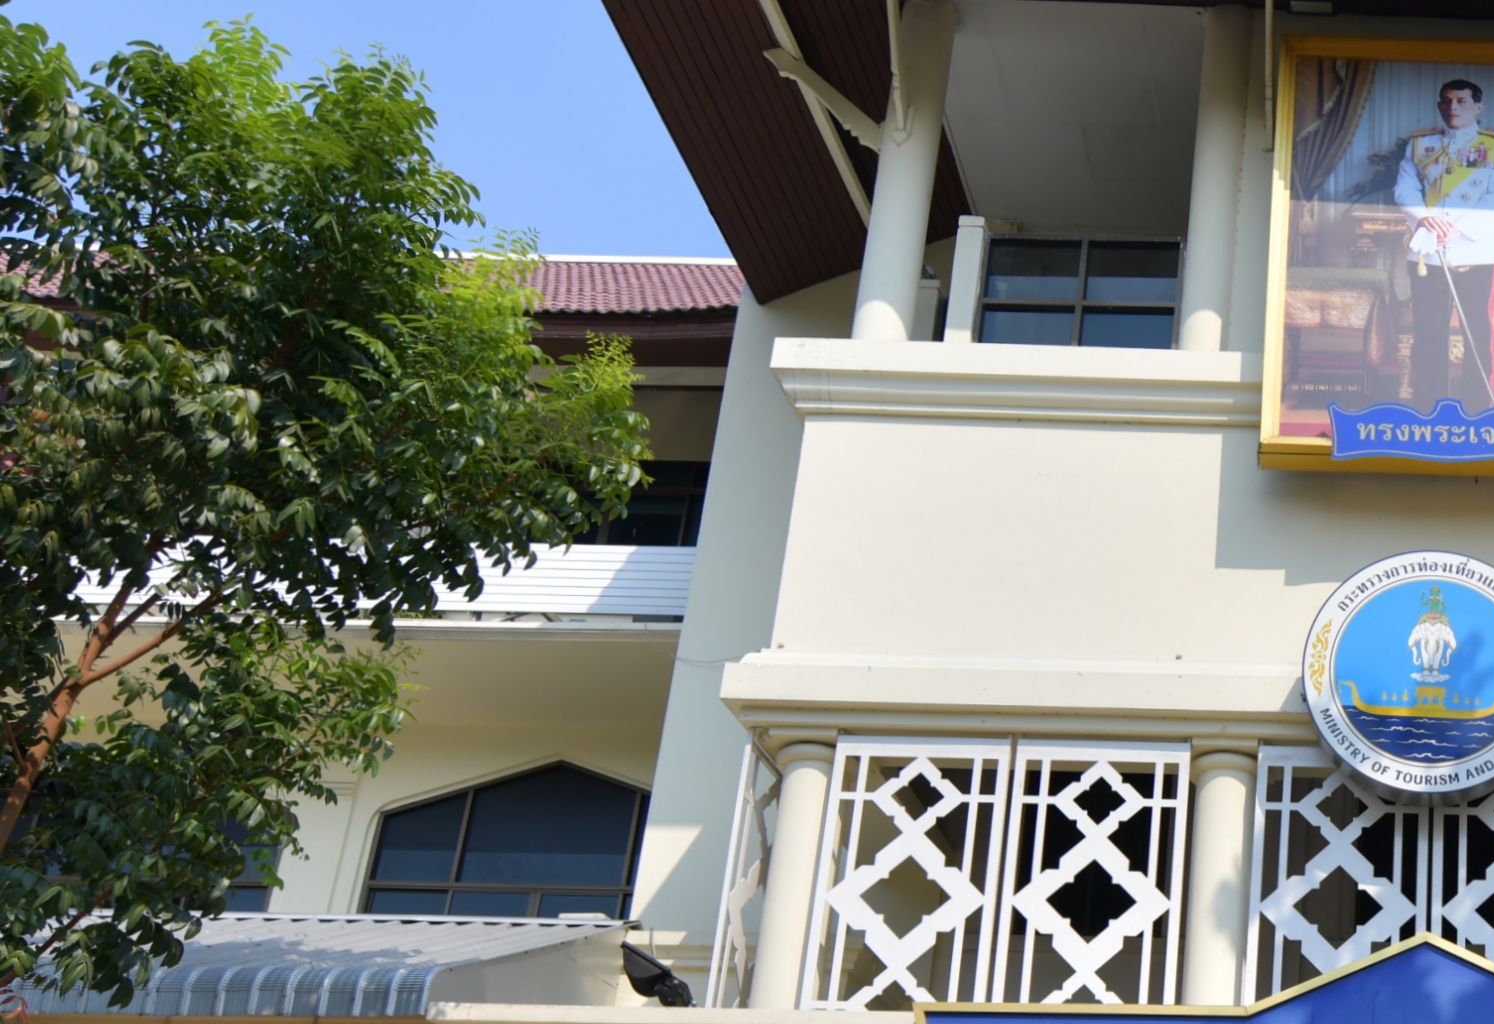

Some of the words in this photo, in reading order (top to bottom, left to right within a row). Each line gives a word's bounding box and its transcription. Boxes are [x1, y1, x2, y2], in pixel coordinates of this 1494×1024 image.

[1319, 707, 1370, 764] MINISTRY
[1371, 761, 1391, 776] OF
[1395, 769, 1460, 786] TOURISM
[1466, 762, 1494, 780] AND
